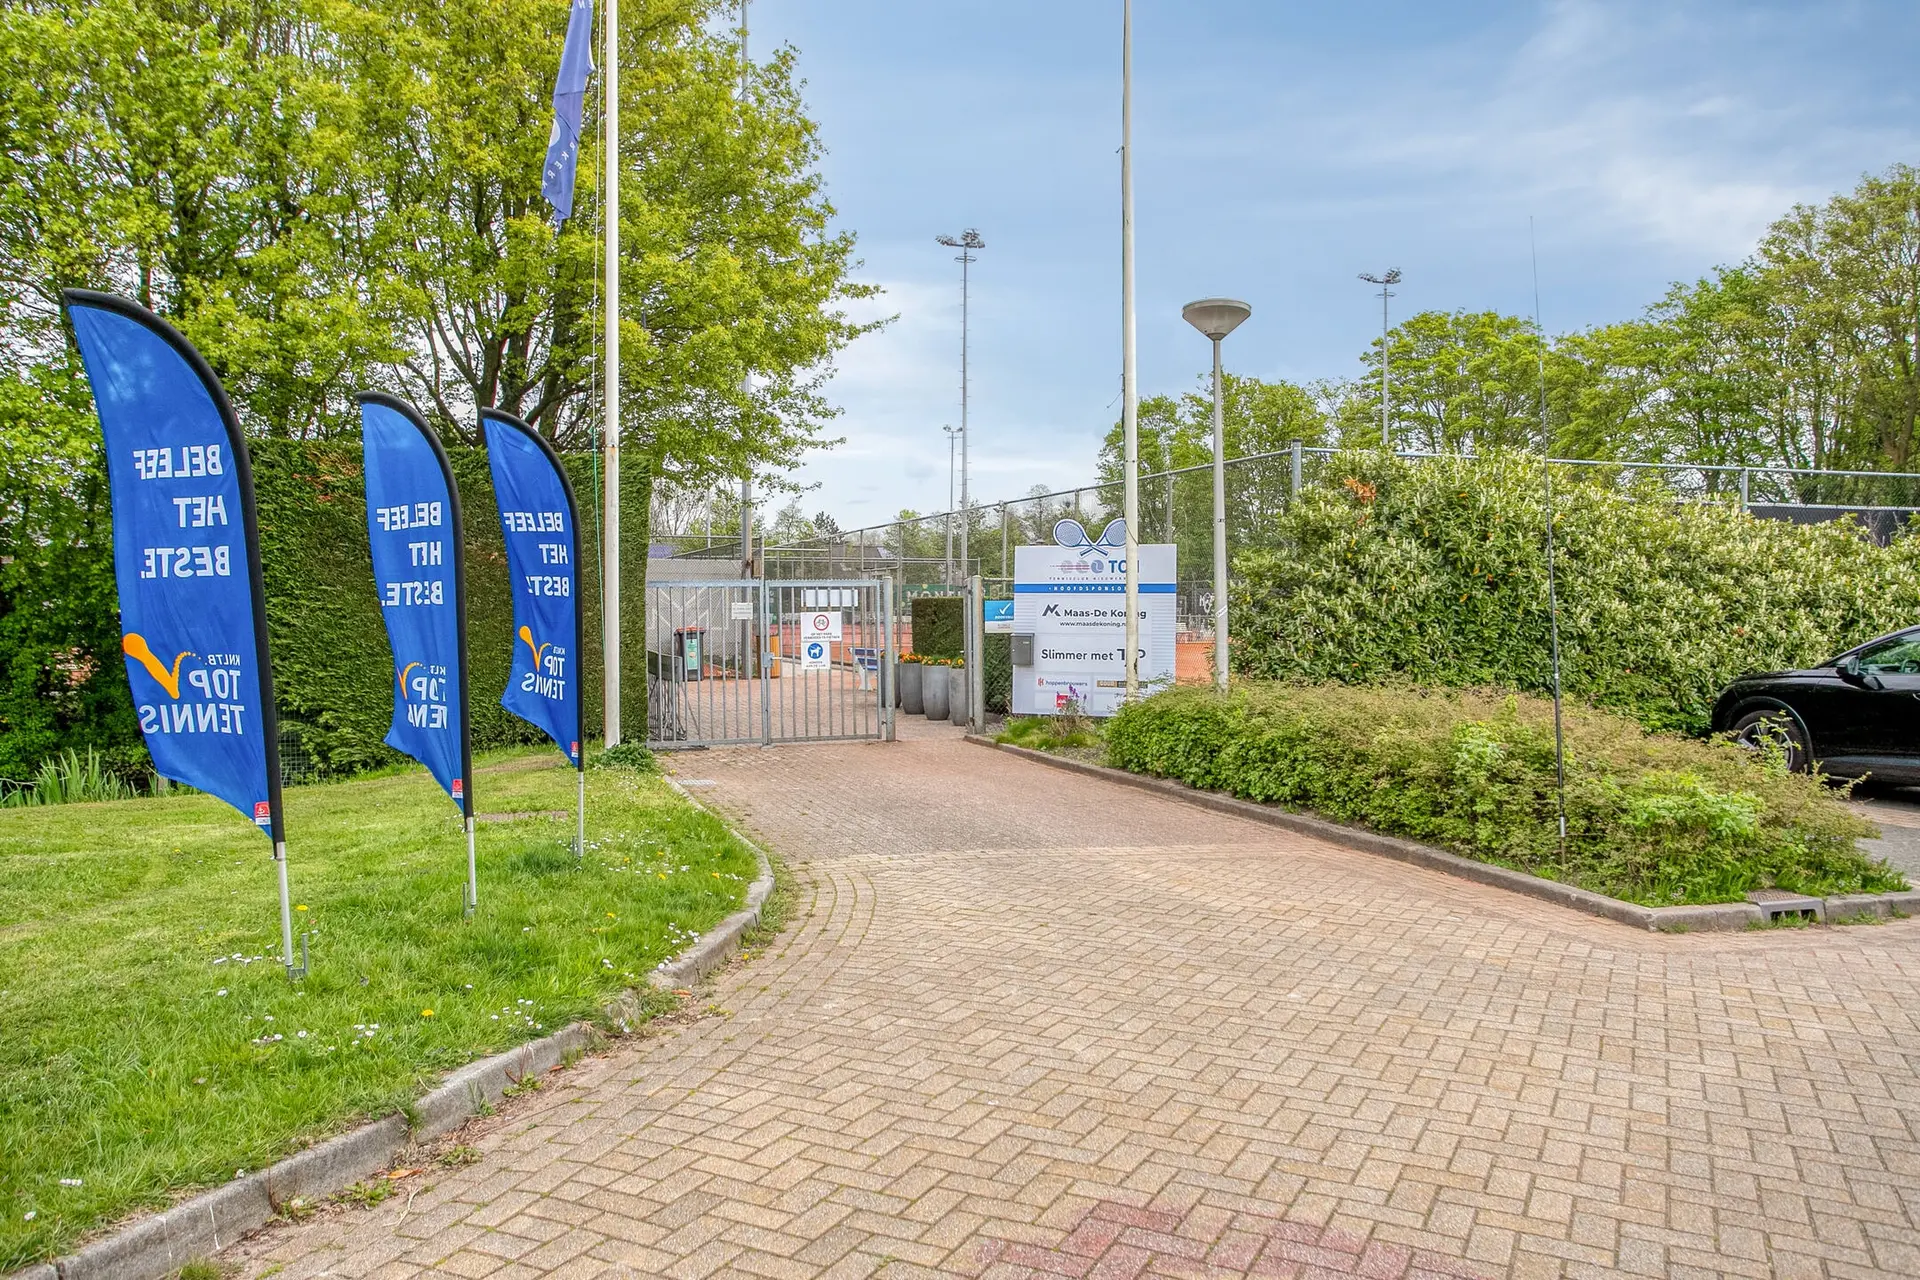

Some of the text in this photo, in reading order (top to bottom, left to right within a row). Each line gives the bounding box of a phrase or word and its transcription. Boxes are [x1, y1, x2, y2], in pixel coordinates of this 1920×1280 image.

[1108, 559, 1139, 574] TC
[1064, 608, 1108, 618] Maas-De
[1041, 648, 1088, 661] Slimmer
[1090, 649, 1114, 661] met
